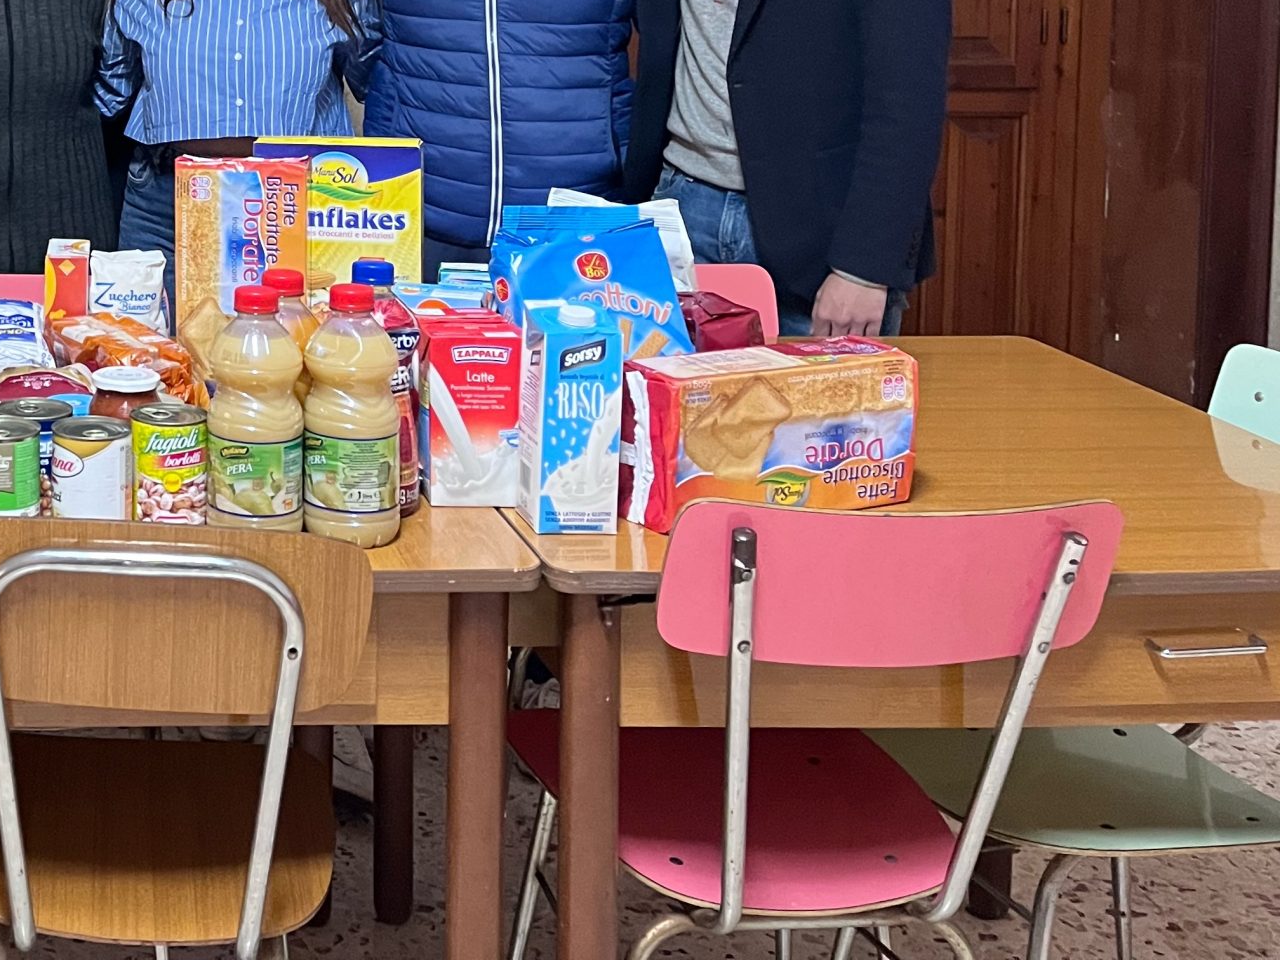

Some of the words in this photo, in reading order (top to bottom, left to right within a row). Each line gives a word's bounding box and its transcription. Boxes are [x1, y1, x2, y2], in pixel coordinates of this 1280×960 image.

[332, 167, 359, 184] Sol
[282, 183, 299, 227] Fette
[265, 176, 282, 265] Biscottate
[308, 207, 406, 230] nflakes
[242, 198, 264, 282] Dorate
[94, 282, 157, 308] Zucchero
[119, 300, 152, 312] Bianco
[393, 334, 420, 350] erby
[466, 370, 495, 383] Latte
[556, 381, 606, 420] RISO
[145, 428, 199, 454] fagioli
[804, 438, 884, 465] Dorate
[164, 451, 201, 467] borlotti
[226, 462, 253, 476] PERA
[306, 454, 327, 465] PERA
[822, 460, 905, 486] Biscottate
[772, 485, 791, 502] Sol
[857, 480, 898, 501] Fette
